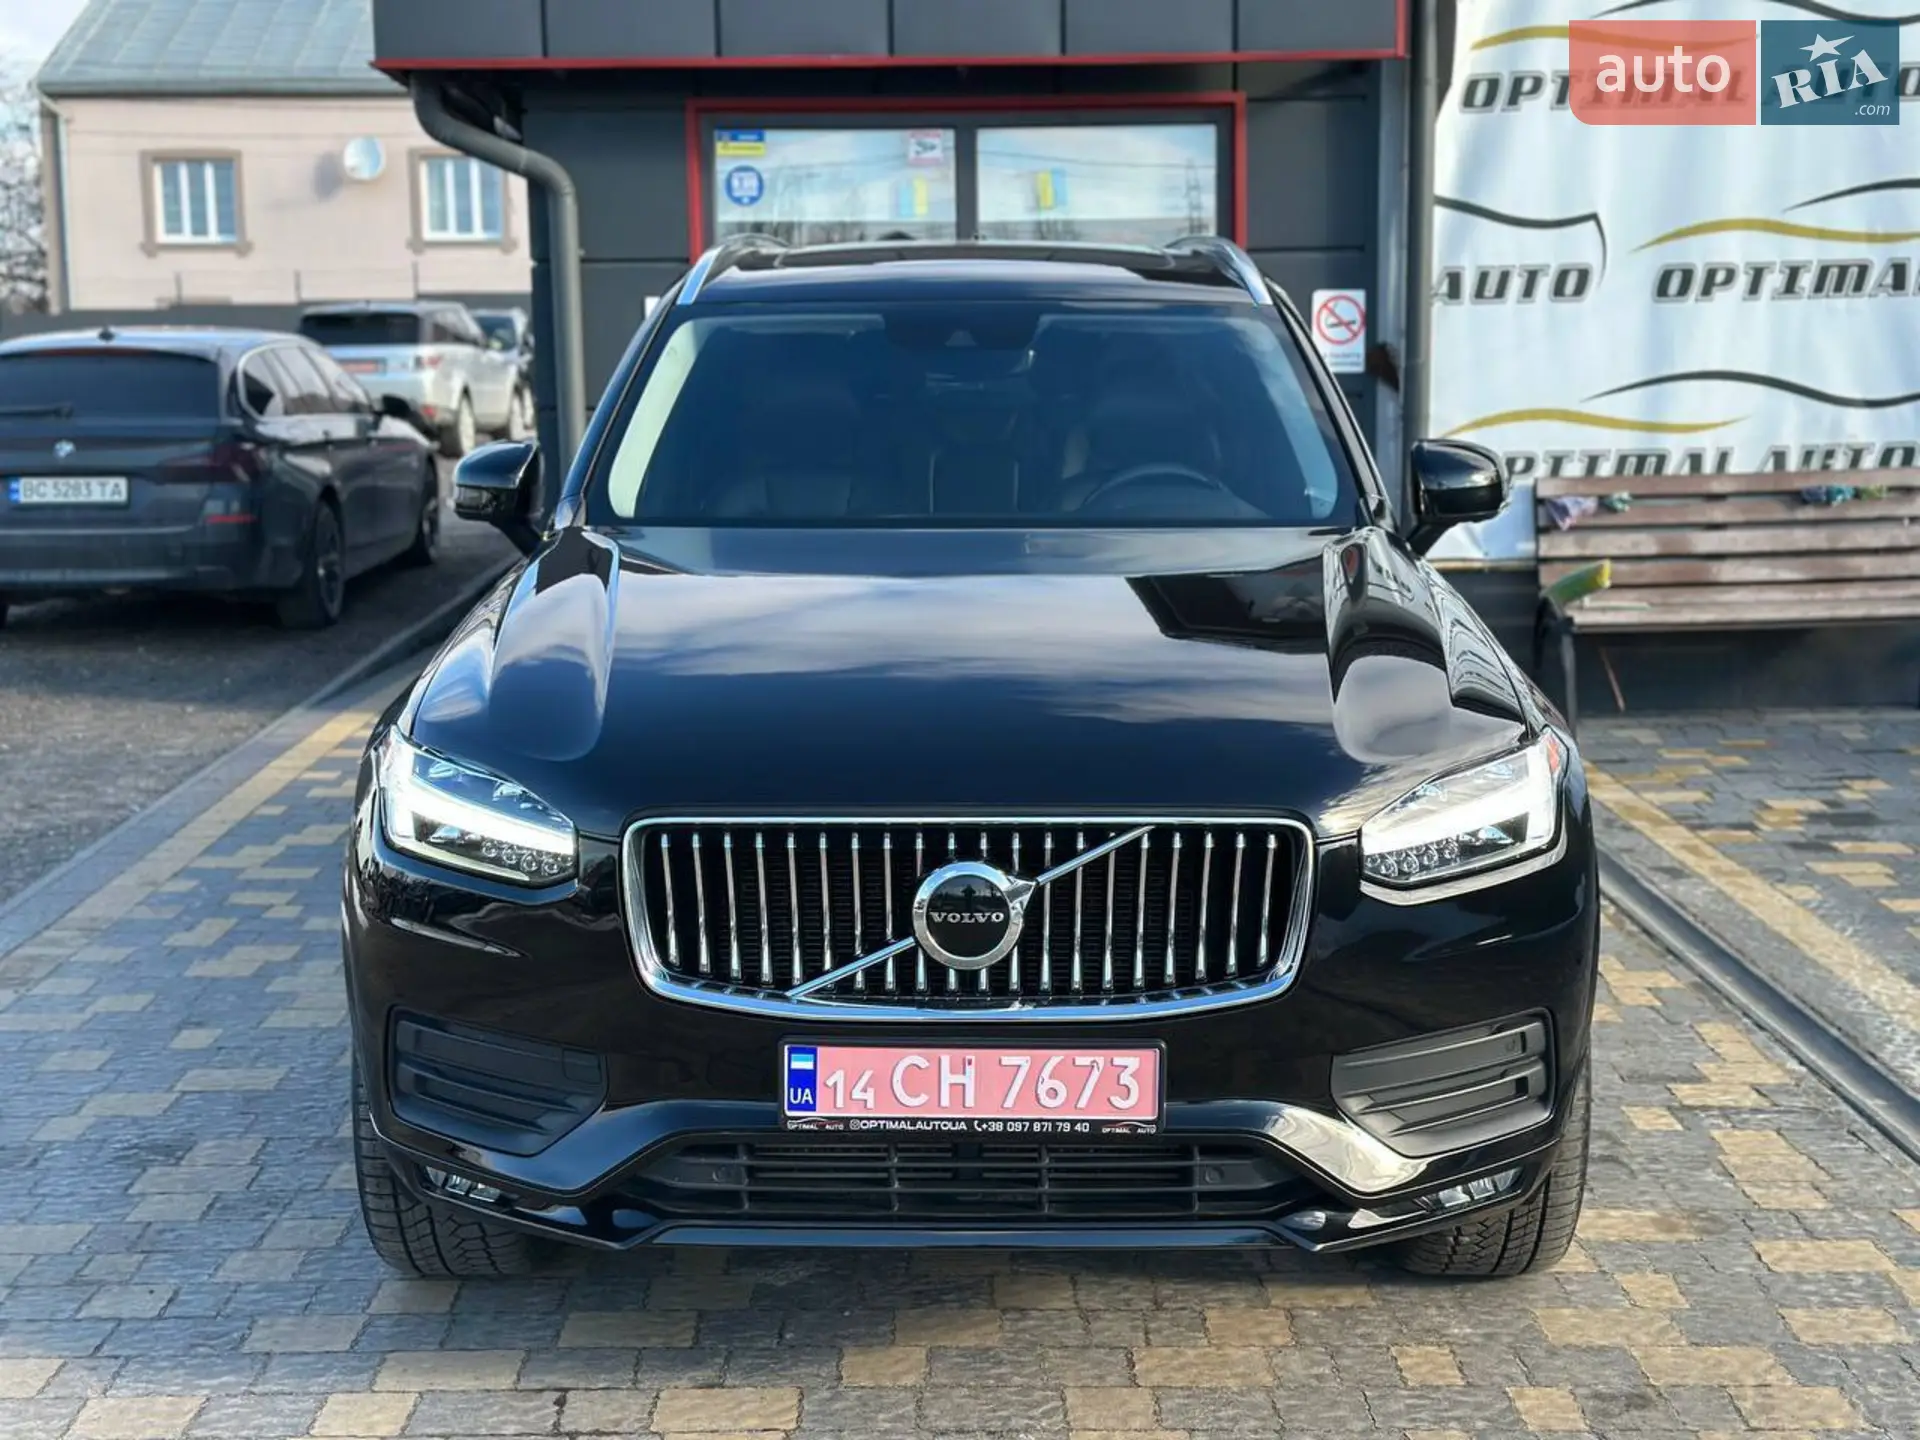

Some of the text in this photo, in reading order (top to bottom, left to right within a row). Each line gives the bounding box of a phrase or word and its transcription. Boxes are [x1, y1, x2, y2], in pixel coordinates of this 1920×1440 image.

[1432, 262, 1593, 304] AUTO
[1652, 257, 1920, 303] OPTIMA
[23, 481, 48, 499] BC
[97, 481, 122, 498] TA
[929, 911, 1005, 924] VOLVO
[823, 1054, 1141, 1111] 14 CH 7673
[790, 1087, 814, 1105] UA
[981, 1121, 1004, 1131] +38
[1007, 1121, 1030, 1132] 097
[1055, 1121, 1071, 1132] 79
[1074, 1122, 1090, 1132] 40
